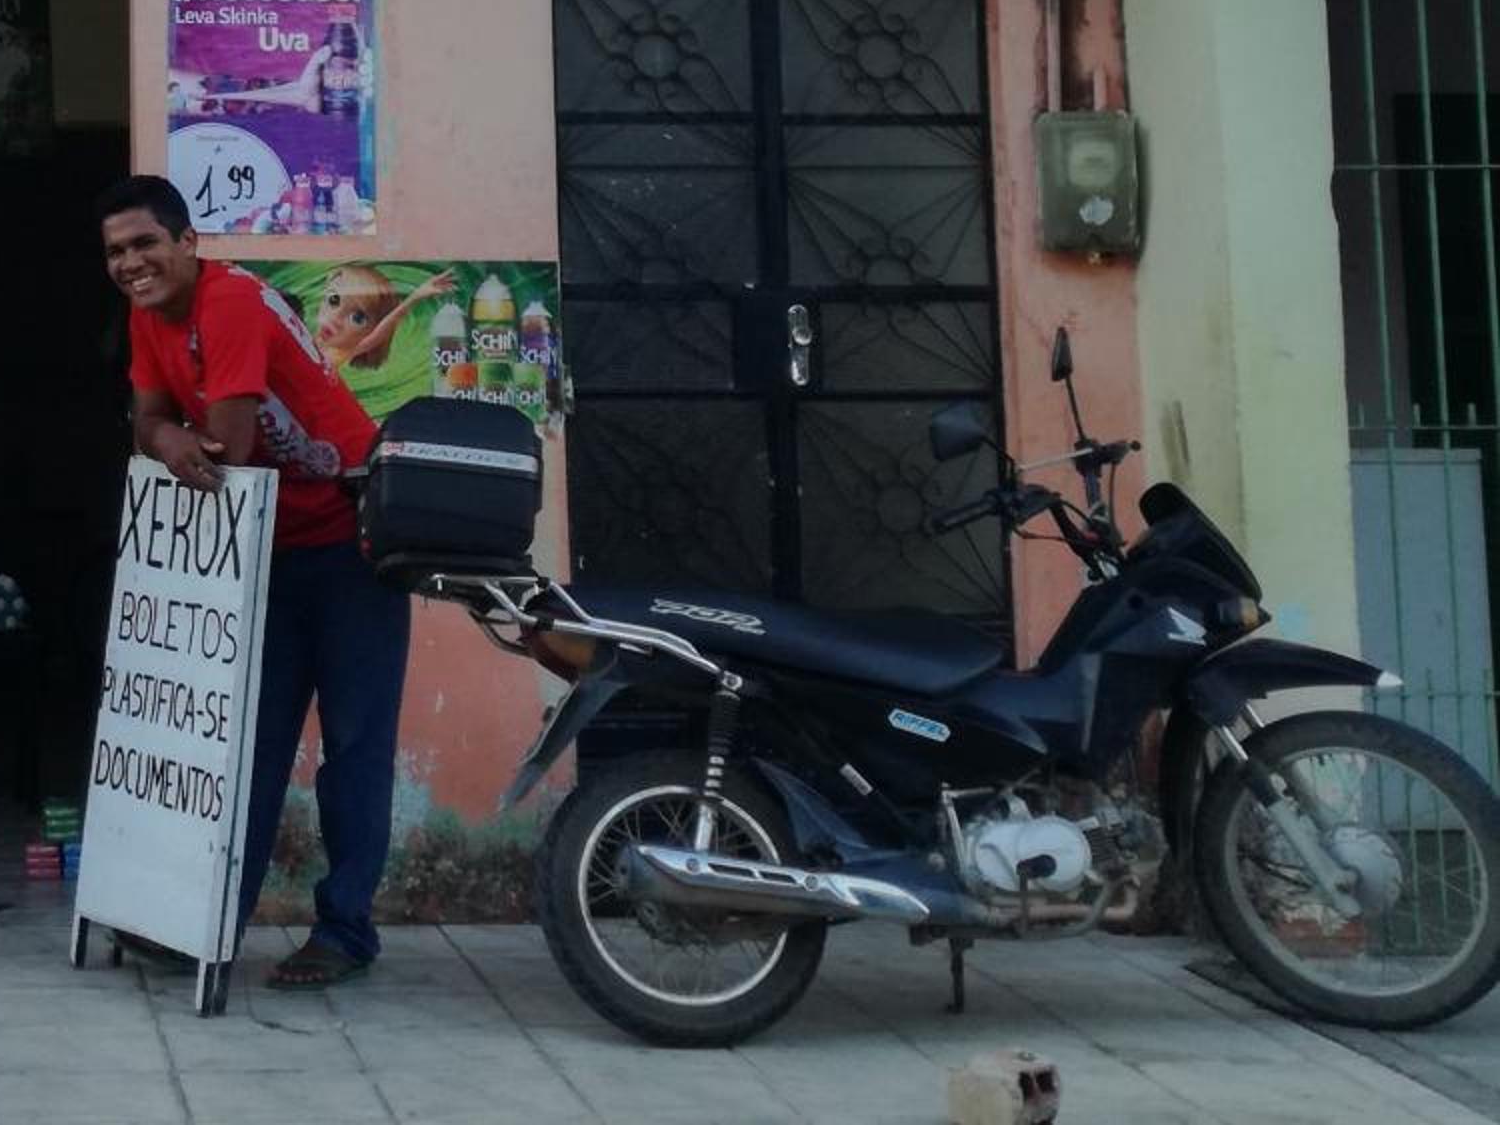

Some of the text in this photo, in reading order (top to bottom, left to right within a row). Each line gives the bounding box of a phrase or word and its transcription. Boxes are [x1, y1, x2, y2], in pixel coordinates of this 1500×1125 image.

[175, 7, 279, 25] Leva Skinka
[258, 26, 310, 52] Uva
[194, 164, 257, 218] 1.99
[116, 475, 248, 580] XEROX
[117, 590, 239, 664] BOLETOS
[102, 665, 232, 743] PLASTIFICA-SE
[94, 739, 225, 822] DOCUMENTOS
